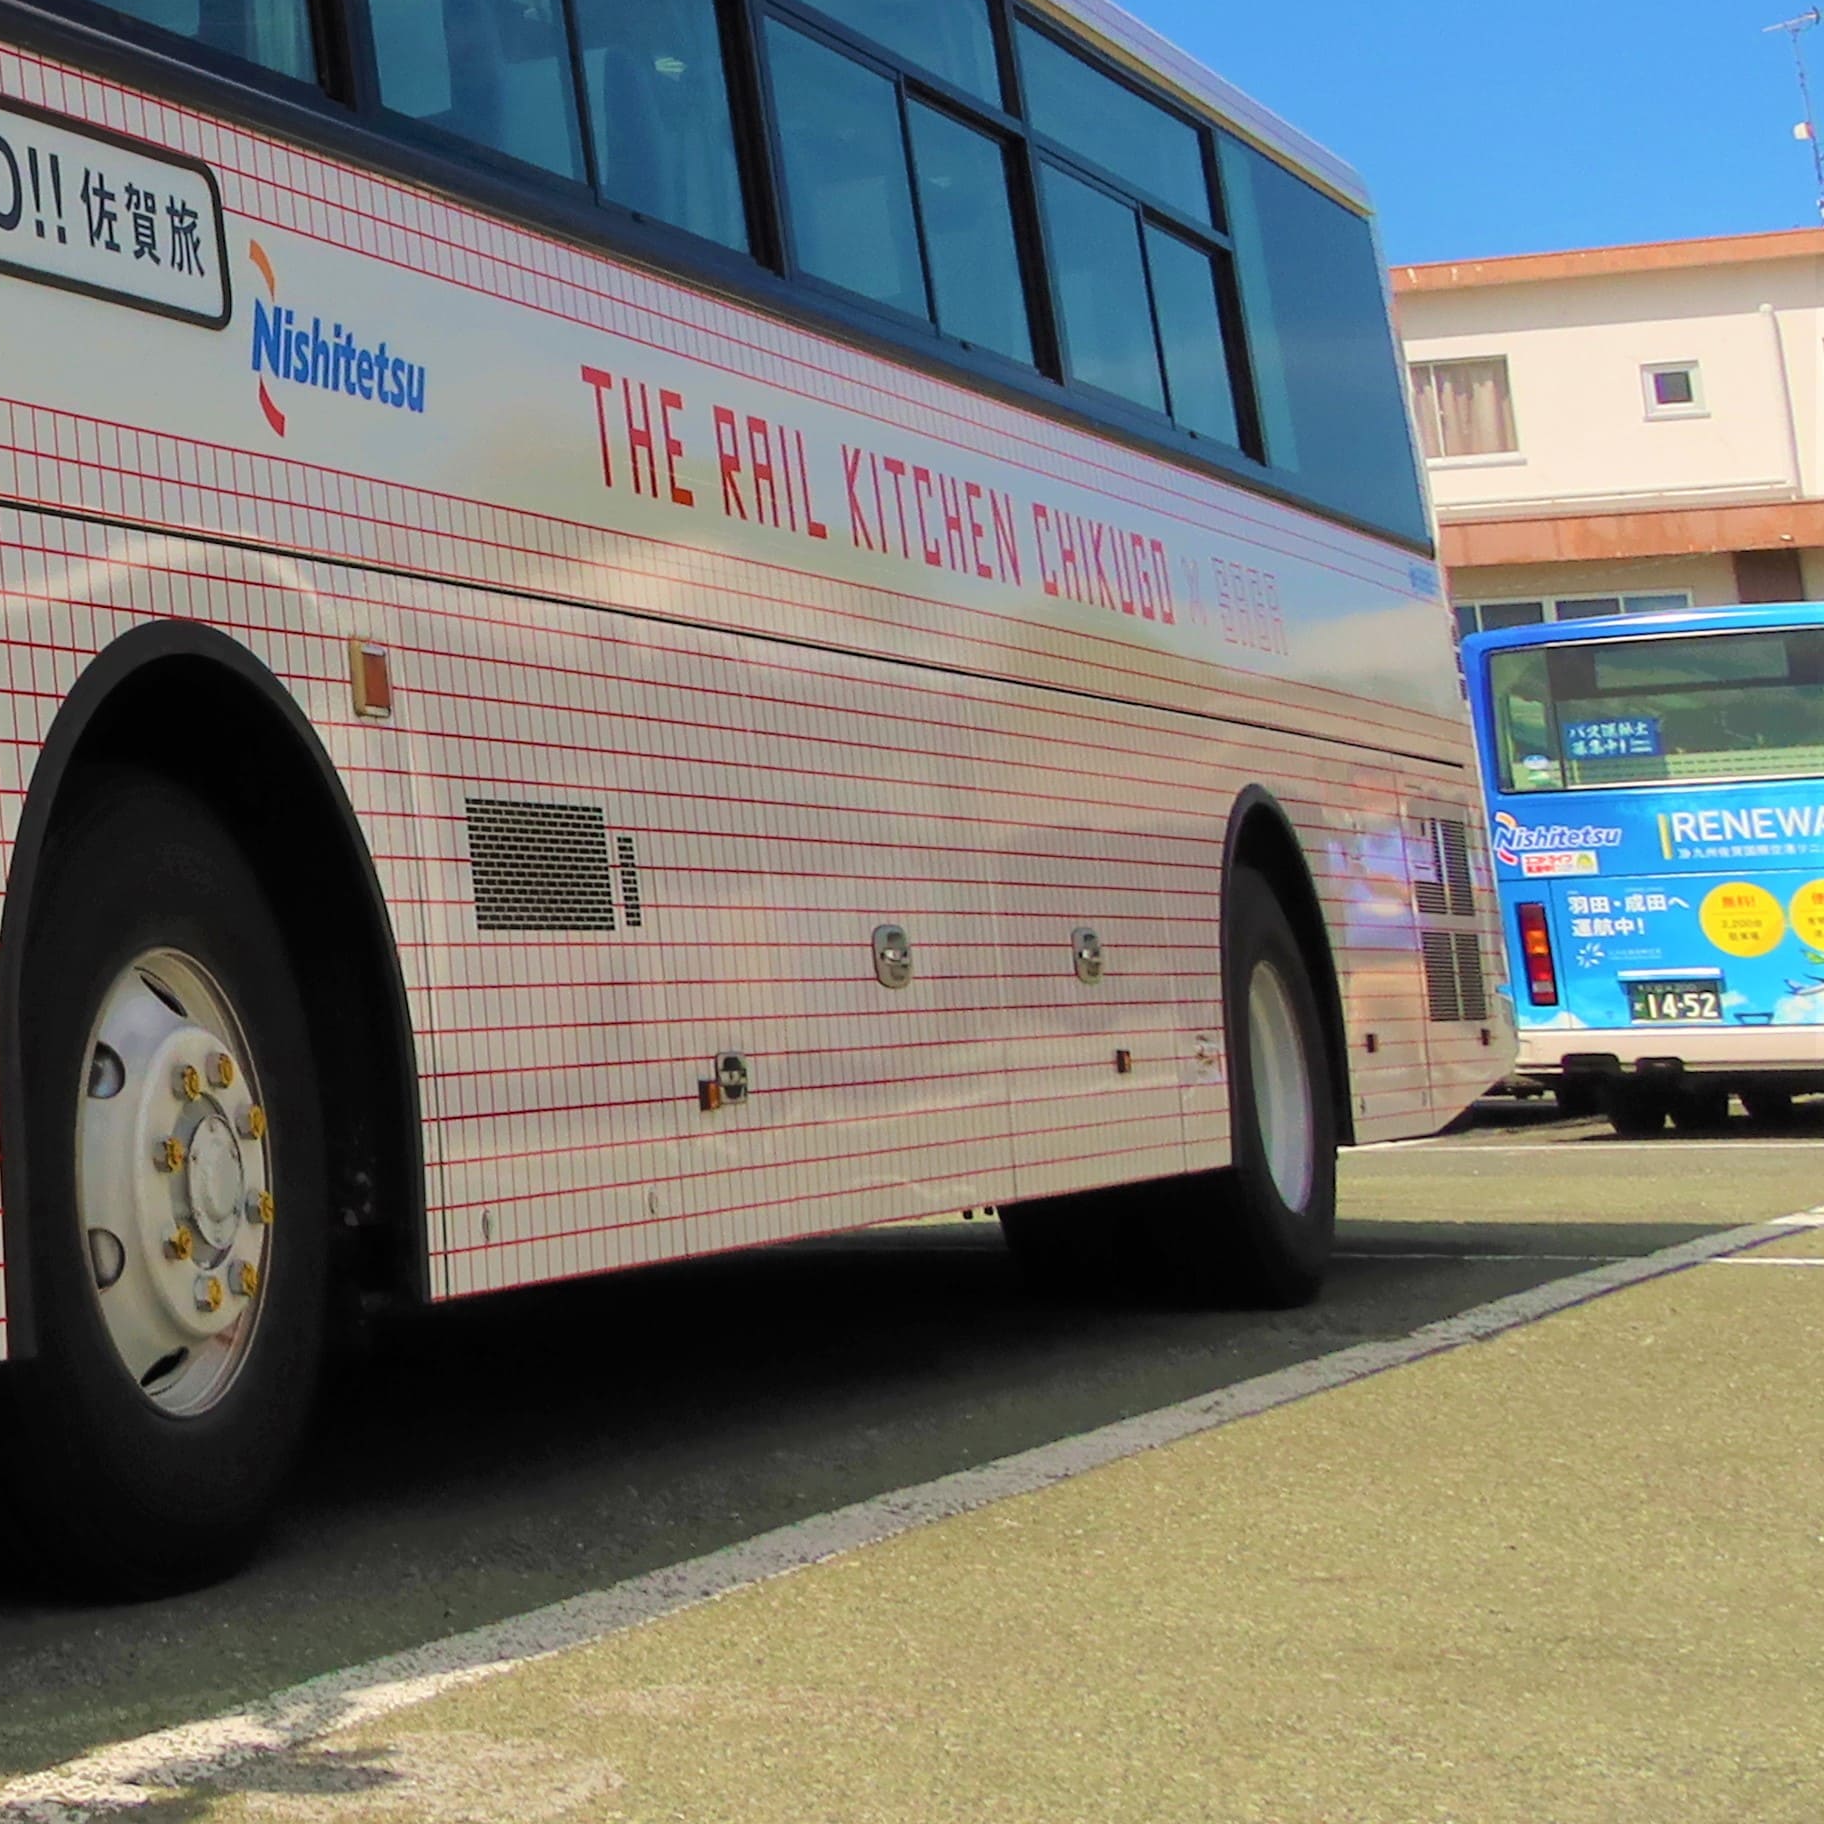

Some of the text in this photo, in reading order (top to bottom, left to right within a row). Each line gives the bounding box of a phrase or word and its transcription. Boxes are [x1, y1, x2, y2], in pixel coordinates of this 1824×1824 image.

[80, 166, 207, 278] 佐賀旅
[251, 296, 427, 413] Nishitetsu
[581, 365, 695, 508] THE
[712, 405, 827, 540] RAIL
[841, 443, 1021, 588] KITCHEN
[1032, 501, 1176, 625] CHIKUGO
[1495, 826, 1621, 850] Nishitetsu
[1647, 991, 1719, 1019] 14-52
